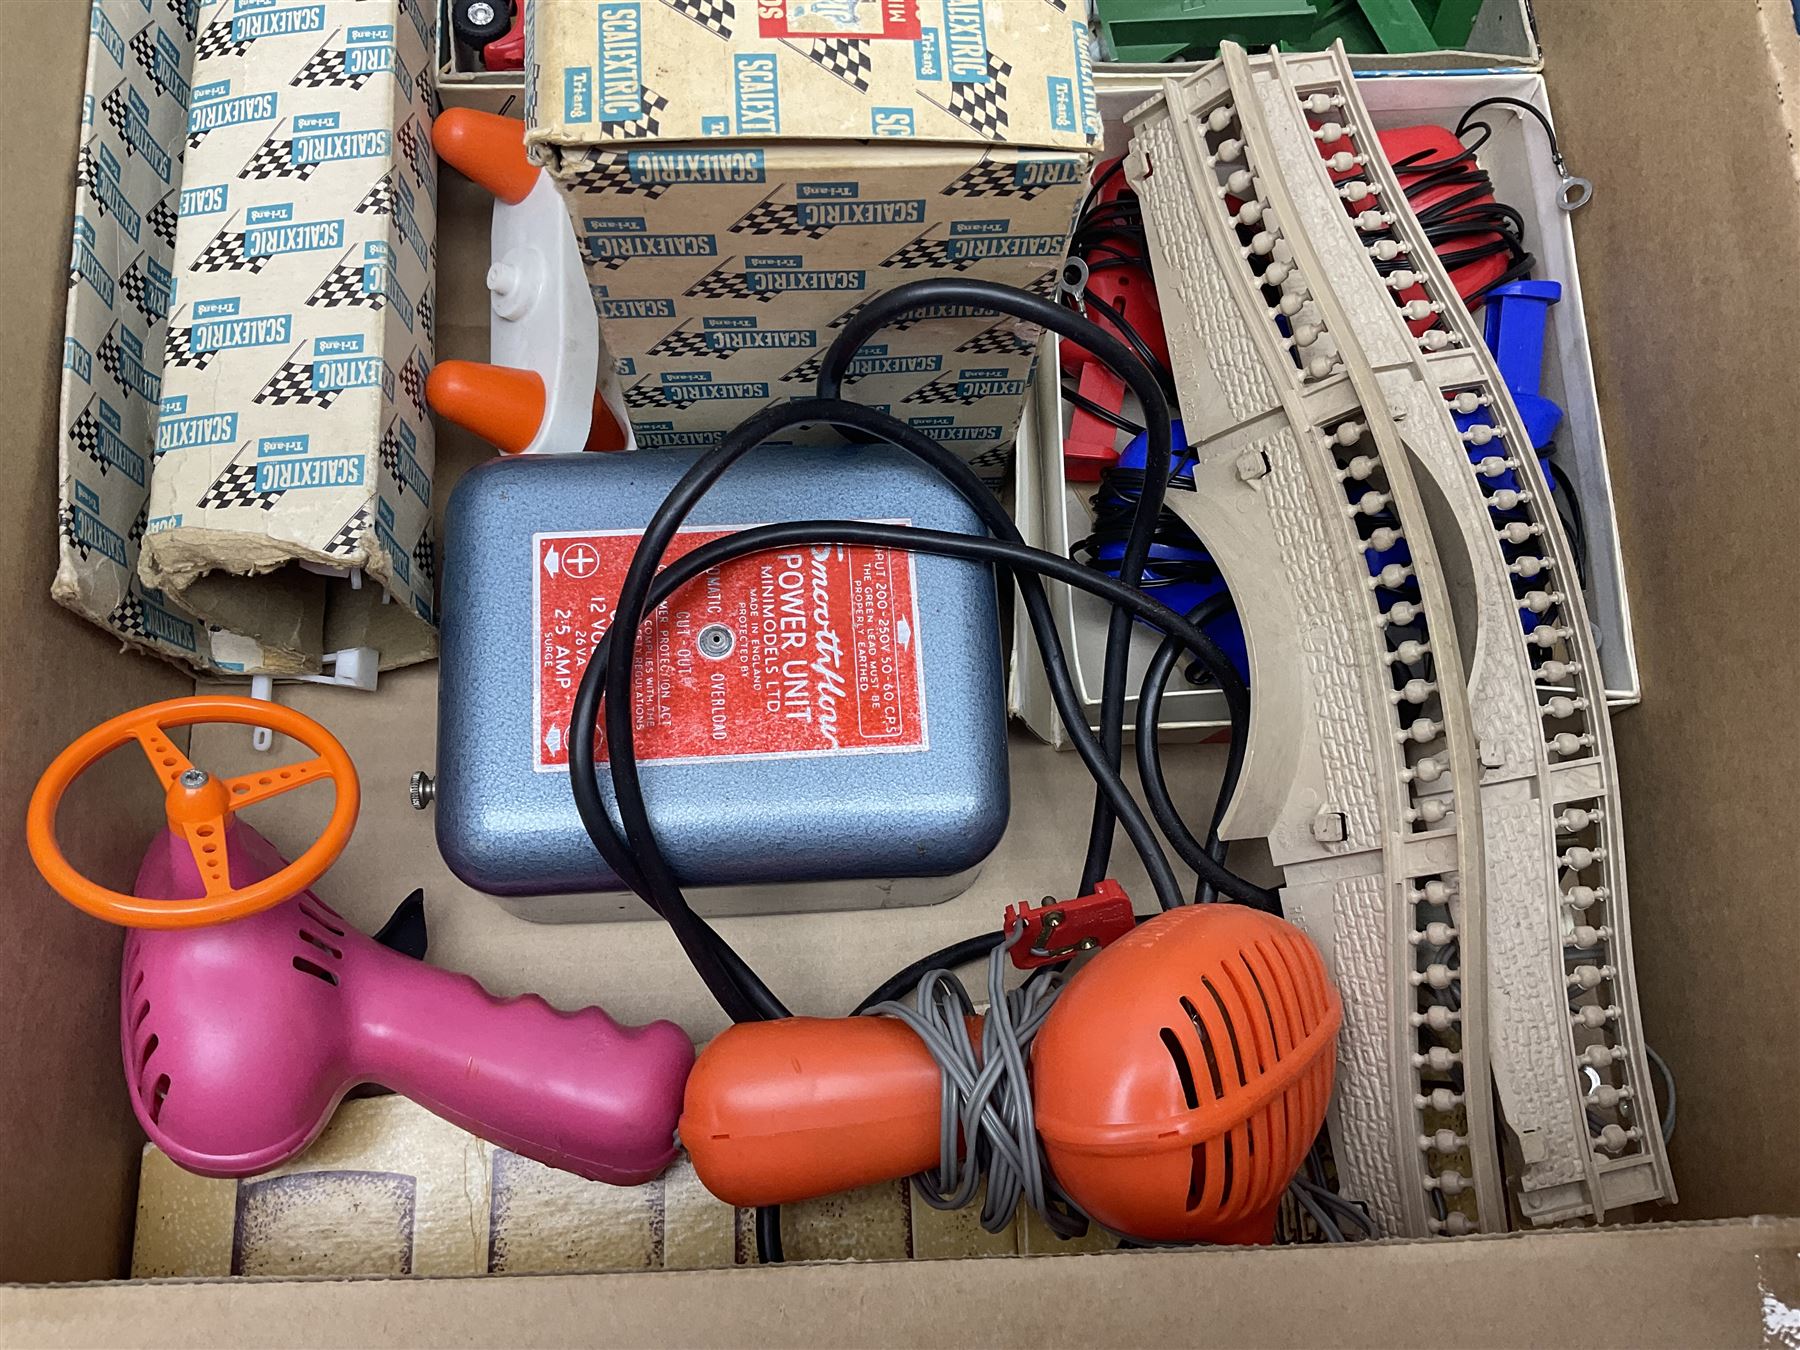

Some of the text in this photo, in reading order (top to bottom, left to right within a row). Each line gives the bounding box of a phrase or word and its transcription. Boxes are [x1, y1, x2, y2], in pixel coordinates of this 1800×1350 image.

[237, 8, 320, 39] SCALEXTRIC
[602, 8, 640, 115] SCALEXTRIC
[193, 85, 226, 98] Tri-ang
[570, 72, 588, 119] Tri-ang
[191, 95, 272, 131] SCALEXTRIC
[298, 117, 335, 129] Tri-ang
[297, 131, 386, 162] SCALEXTRIC
[637, 153, 758, 183] SCALEXTRIC
[251, 210, 288, 222] Tri-ang
[805, 202, 918, 225] SCALEXTRIC
[250, 223, 339, 255] SCALEXTRIC
[598, 236, 710, 256] SCALEXTRIC
[955, 236, 1065, 258] SCALEXTRIC
[754, 271, 859, 290] SCALEXTRIC
[197, 303, 235, 315] Tri-ang
[196, 319, 286, 351] SCALEXTRIC
[319, 340, 359, 352] Tri-ang
[713, 331, 811, 348] SCALEXTRIC
[672, 383, 764, 400] SCALEXTRIC
[263, 441, 304, 454] Tri-ang
[262, 458, 360, 490] SCALEXTRIC
[590, 597, 607, 613] 12
[544, 632, 554, 667] SURGE
[643, 620, 655, 674] COMPLIES
[738, 602, 750, 679] PROTECTED BY
[750, 588, 762, 692] MADE IN ENGLAND
[760, 565, 781, 714] MINIMODELS LTD
[778, 554, 812, 724] POWER UNIT
[854, 580, 869, 692] PROPERLY EARTHED
[863, 563, 881, 709] THE GREEN LEAD MUST BE
[555, 645, 572, 689] AMP
[659, 630, 672, 699] PROTECTION
[634, 658, 645, 732] REGULATIONS
[710, 673, 728, 741] OVERLOAD
[660, 705, 673, 727] ACT
